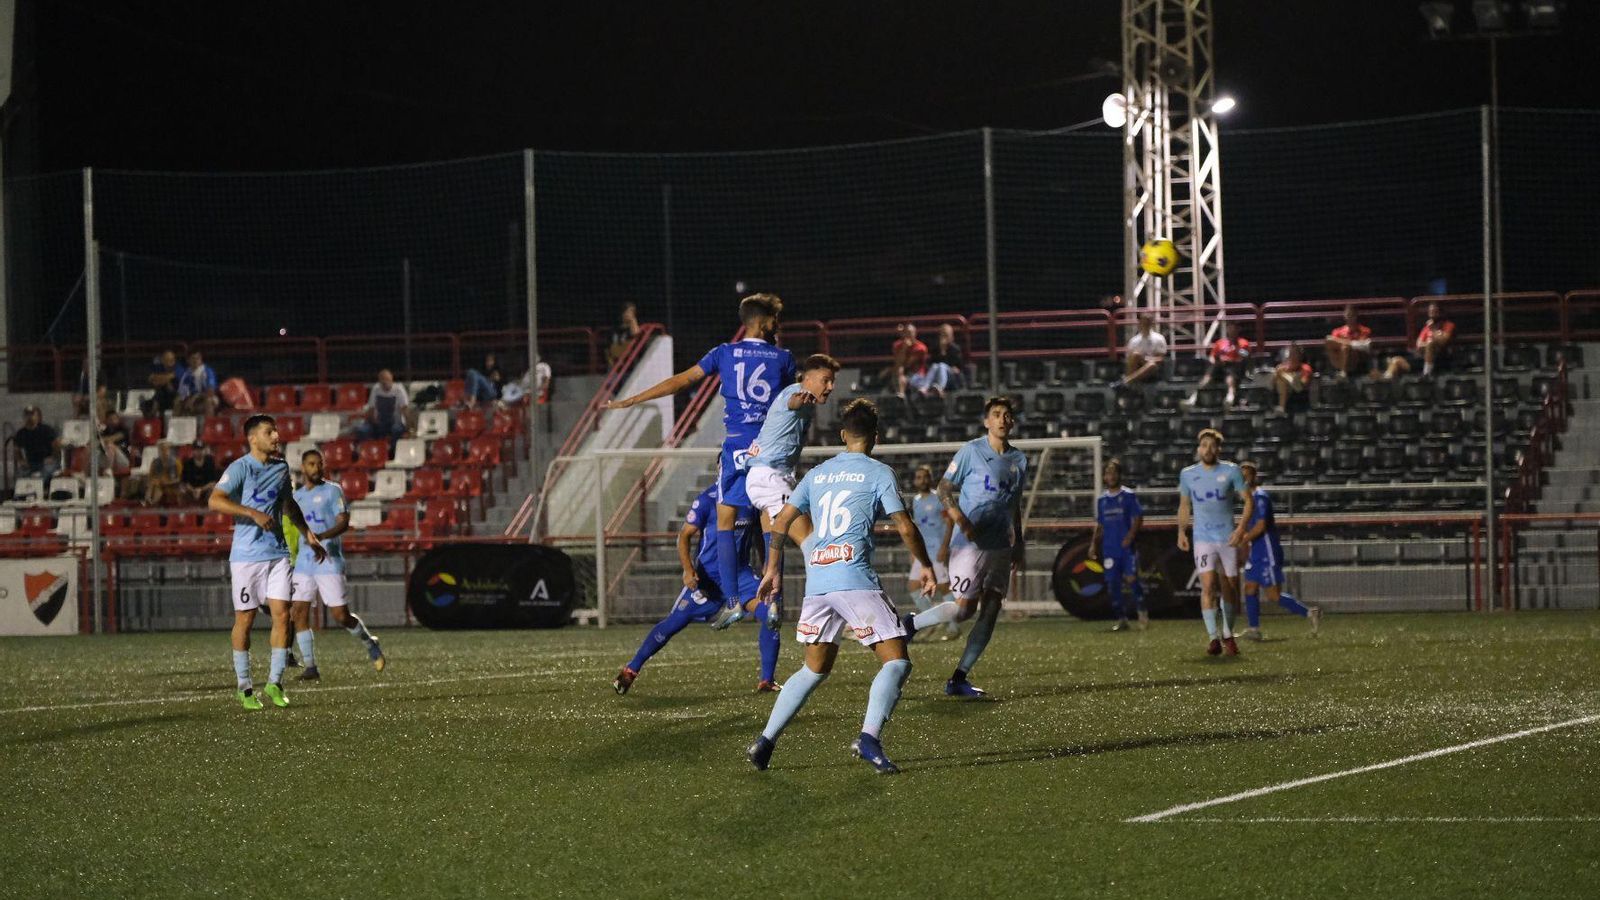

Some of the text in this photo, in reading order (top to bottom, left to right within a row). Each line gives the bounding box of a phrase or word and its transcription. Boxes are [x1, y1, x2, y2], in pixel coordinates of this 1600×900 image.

[733, 362, 771, 403] 16
[818, 489, 852, 538] 16
[240, 587, 250, 604] 6
[951, 576, 971, 593] 20
